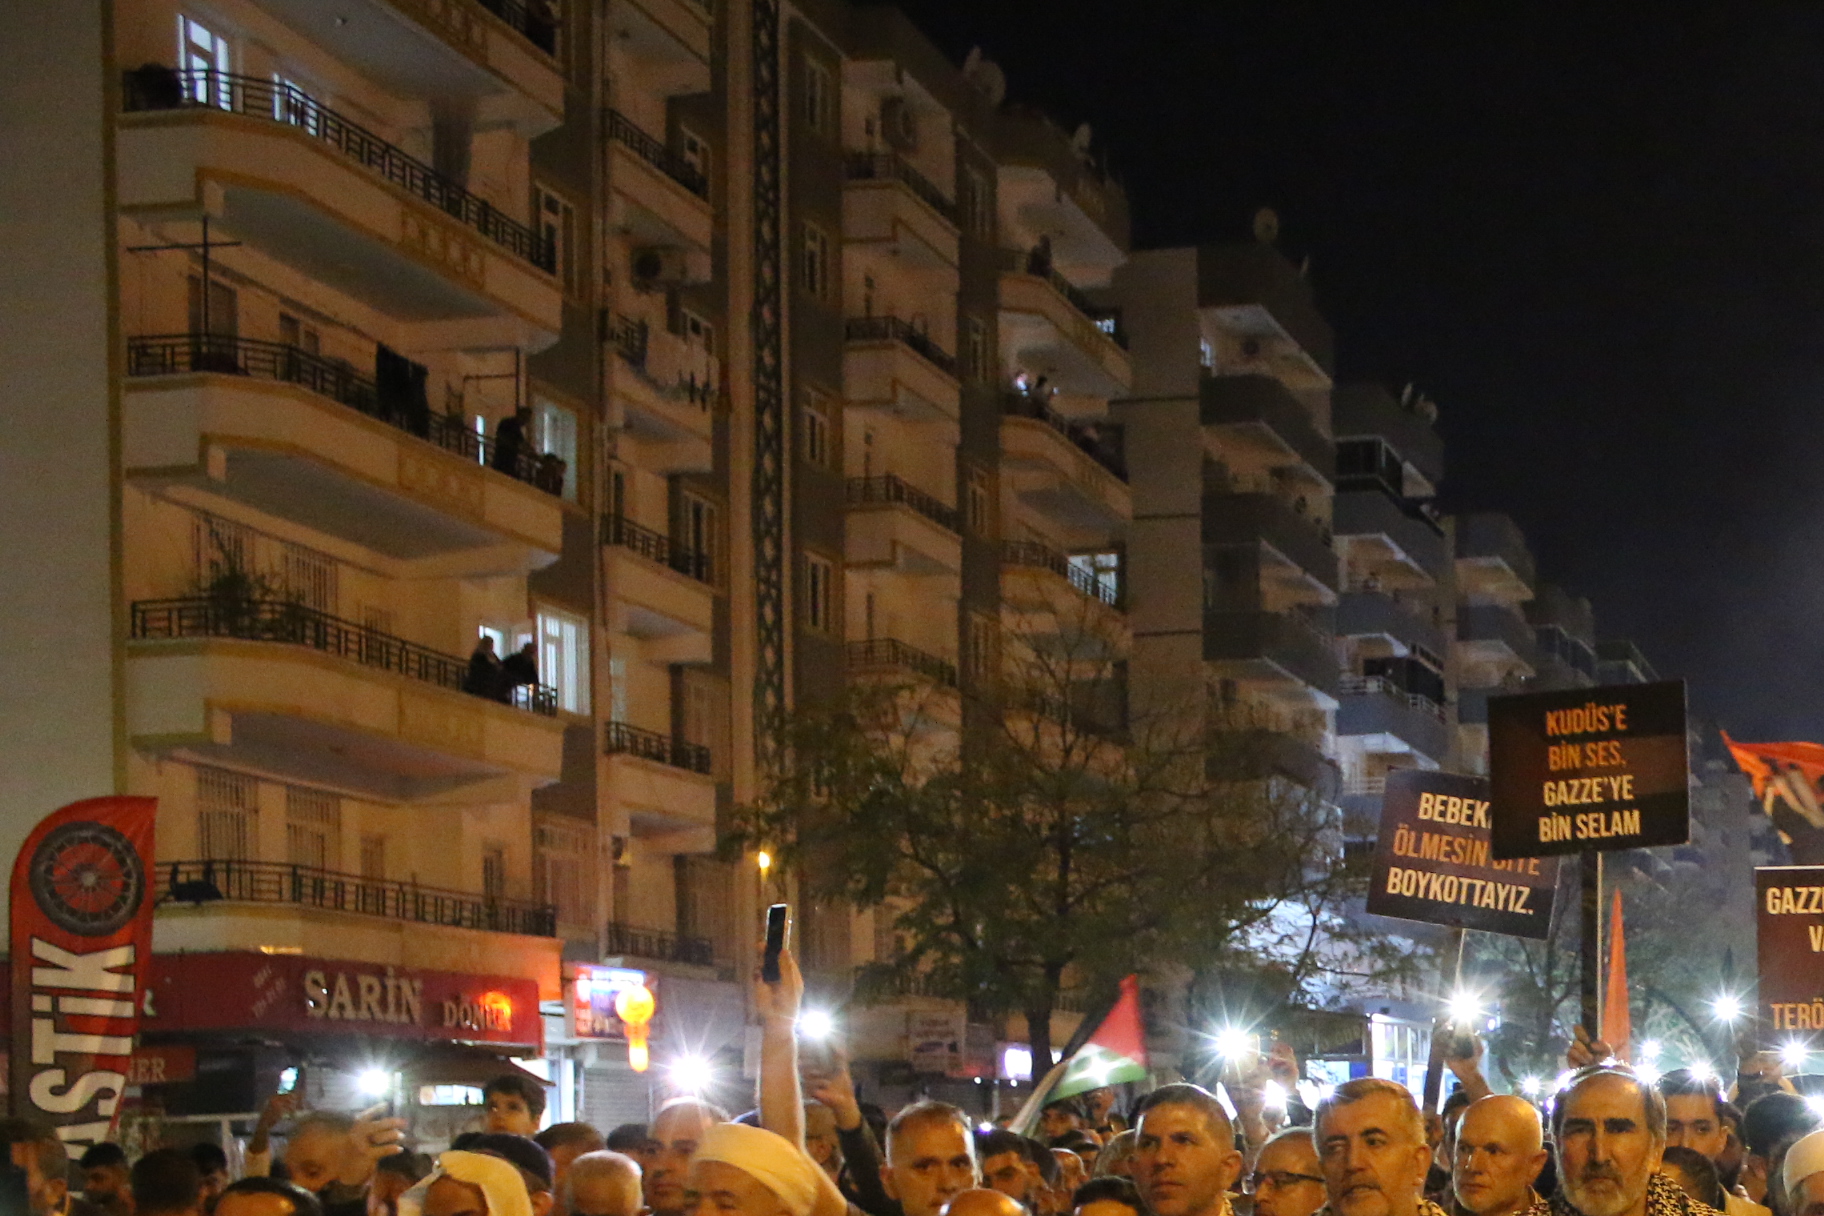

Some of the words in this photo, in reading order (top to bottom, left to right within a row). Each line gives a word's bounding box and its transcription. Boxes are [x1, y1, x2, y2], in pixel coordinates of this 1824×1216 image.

[1546, 702, 1628, 736] KUDÜS'E
[1549, 740, 1581, 771] BİN
[1543, 774, 1634, 807] GAZZE'YE
[1418, 791, 1492, 829] BEBEK
[1539, 812, 1572, 842] BİN
[1575, 809, 1641, 839] SELAM
[1393, 822, 1488, 867] ÖLMESİN
[1386, 866, 1534, 915] BOYKOTTAYIZ.
[304, 966, 424, 1024] SARİN
